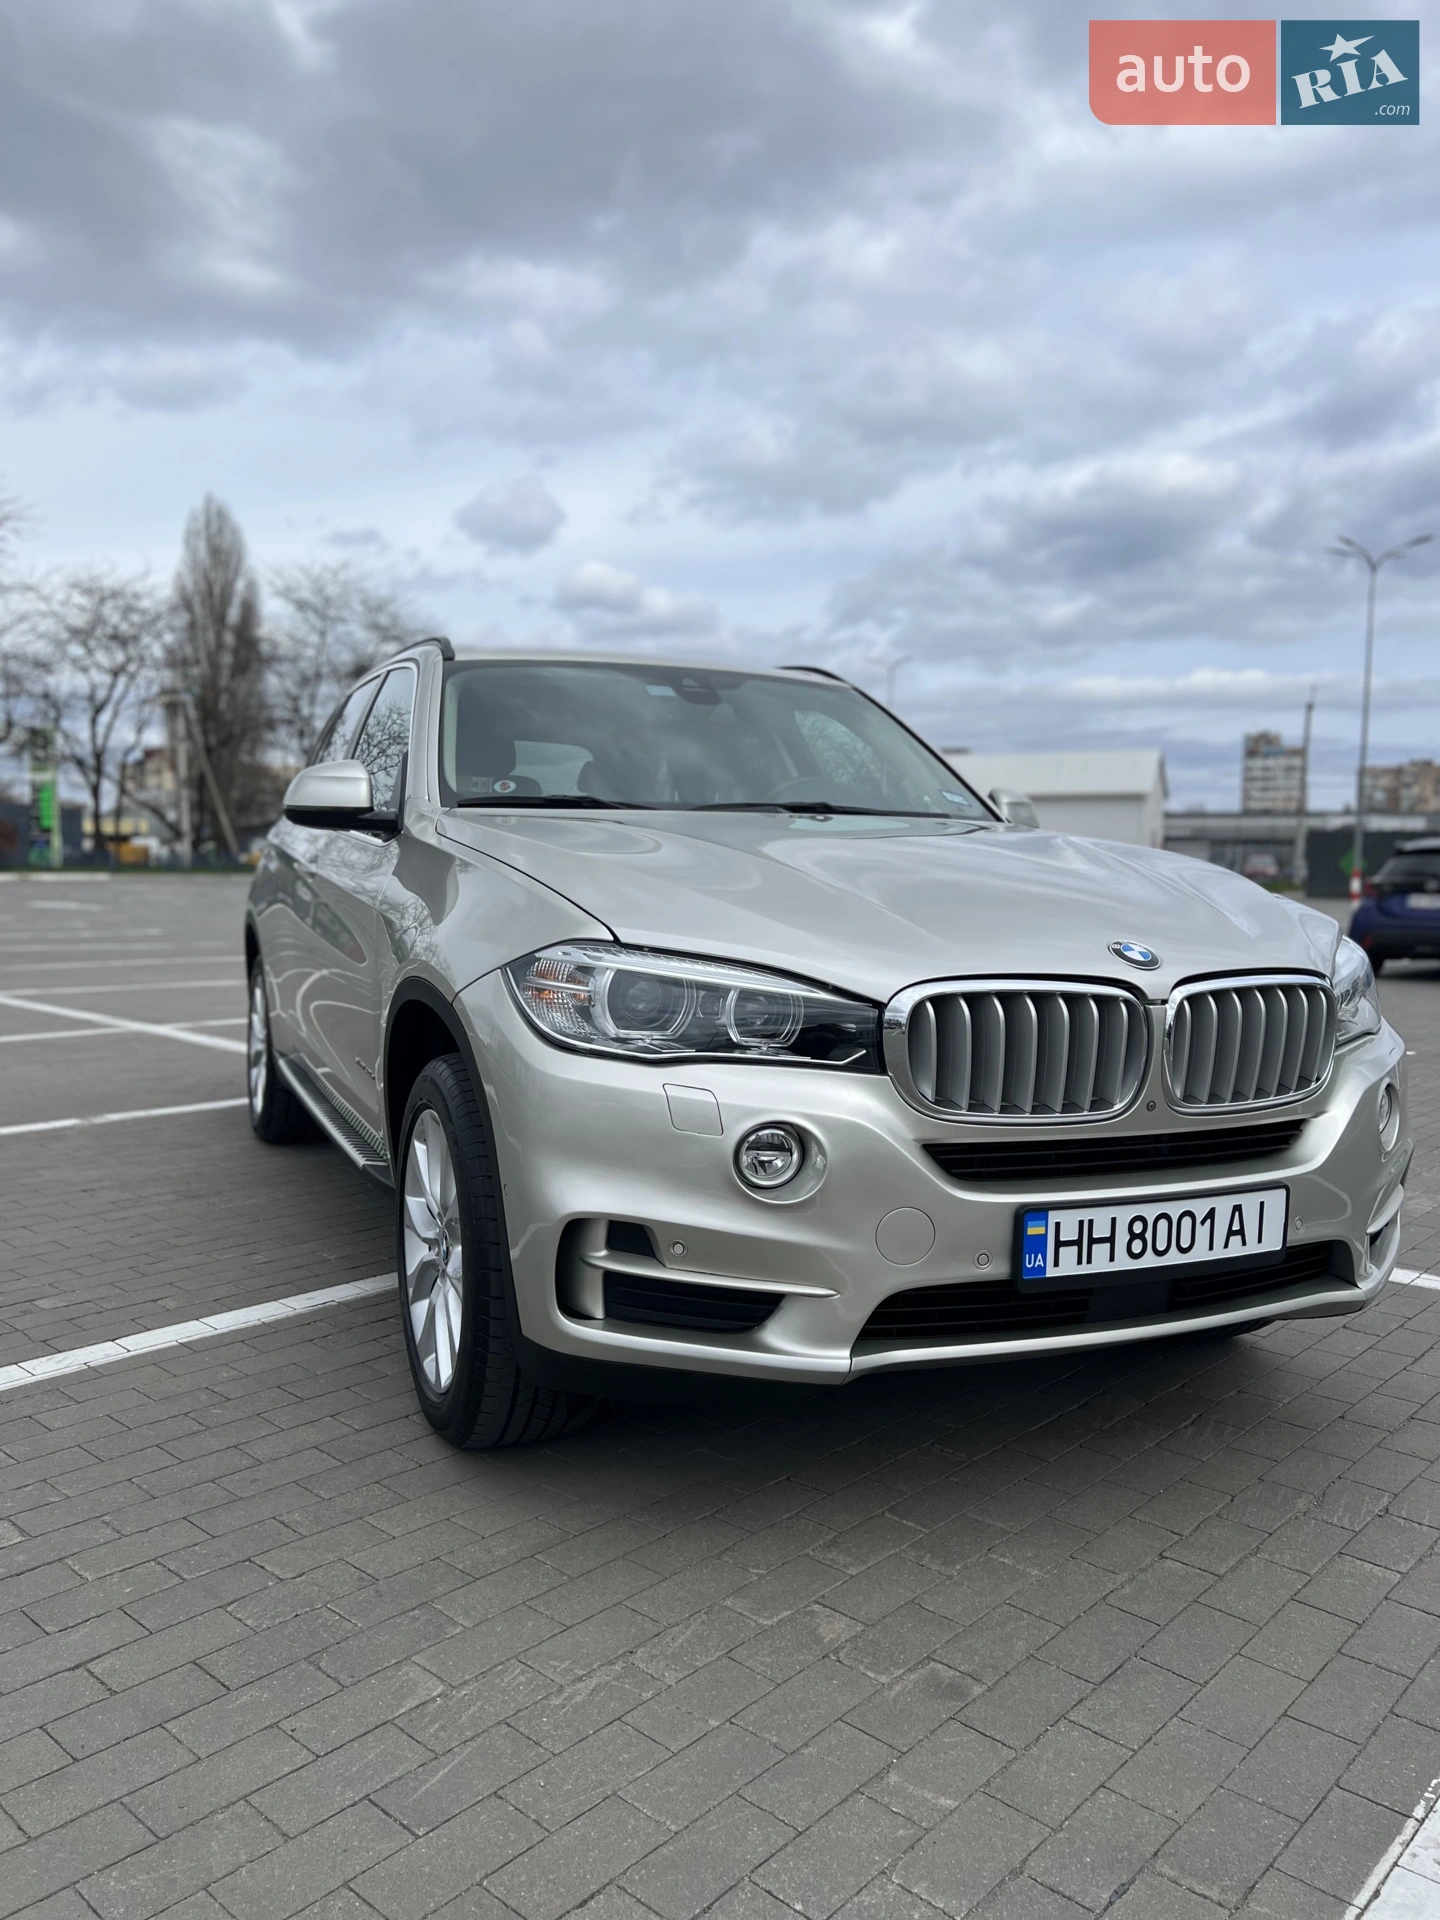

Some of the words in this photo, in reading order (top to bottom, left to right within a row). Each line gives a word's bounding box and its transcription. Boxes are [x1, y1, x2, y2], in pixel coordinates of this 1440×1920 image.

[1053, 1216, 1117, 1268] HH
[1126, 1206, 1216, 1261] 8001
[1025, 1252, 1045, 1269] UA
